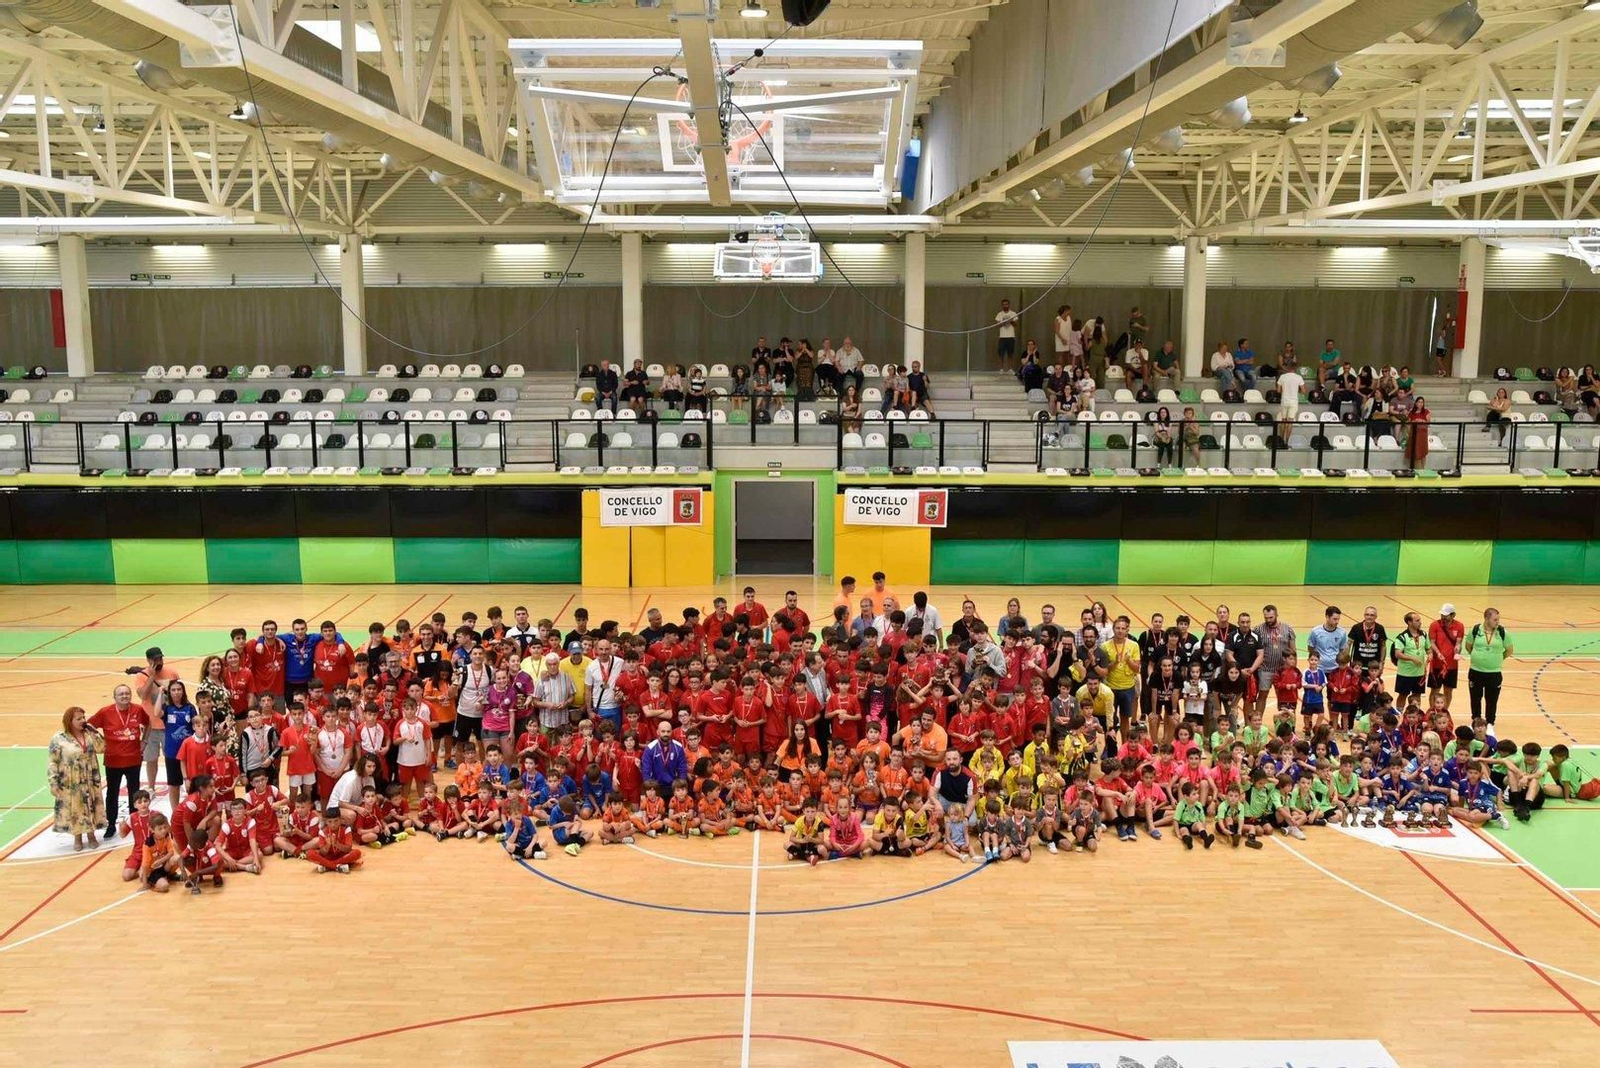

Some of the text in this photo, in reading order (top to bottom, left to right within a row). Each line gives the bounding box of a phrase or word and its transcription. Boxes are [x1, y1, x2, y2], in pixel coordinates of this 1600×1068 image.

[607, 496, 663, 506] CONCELLO
[852, 495, 908, 506] CONCELLO
[614, 507, 657, 516] DE VIGO
[858, 507, 901, 516] DE VIGO
